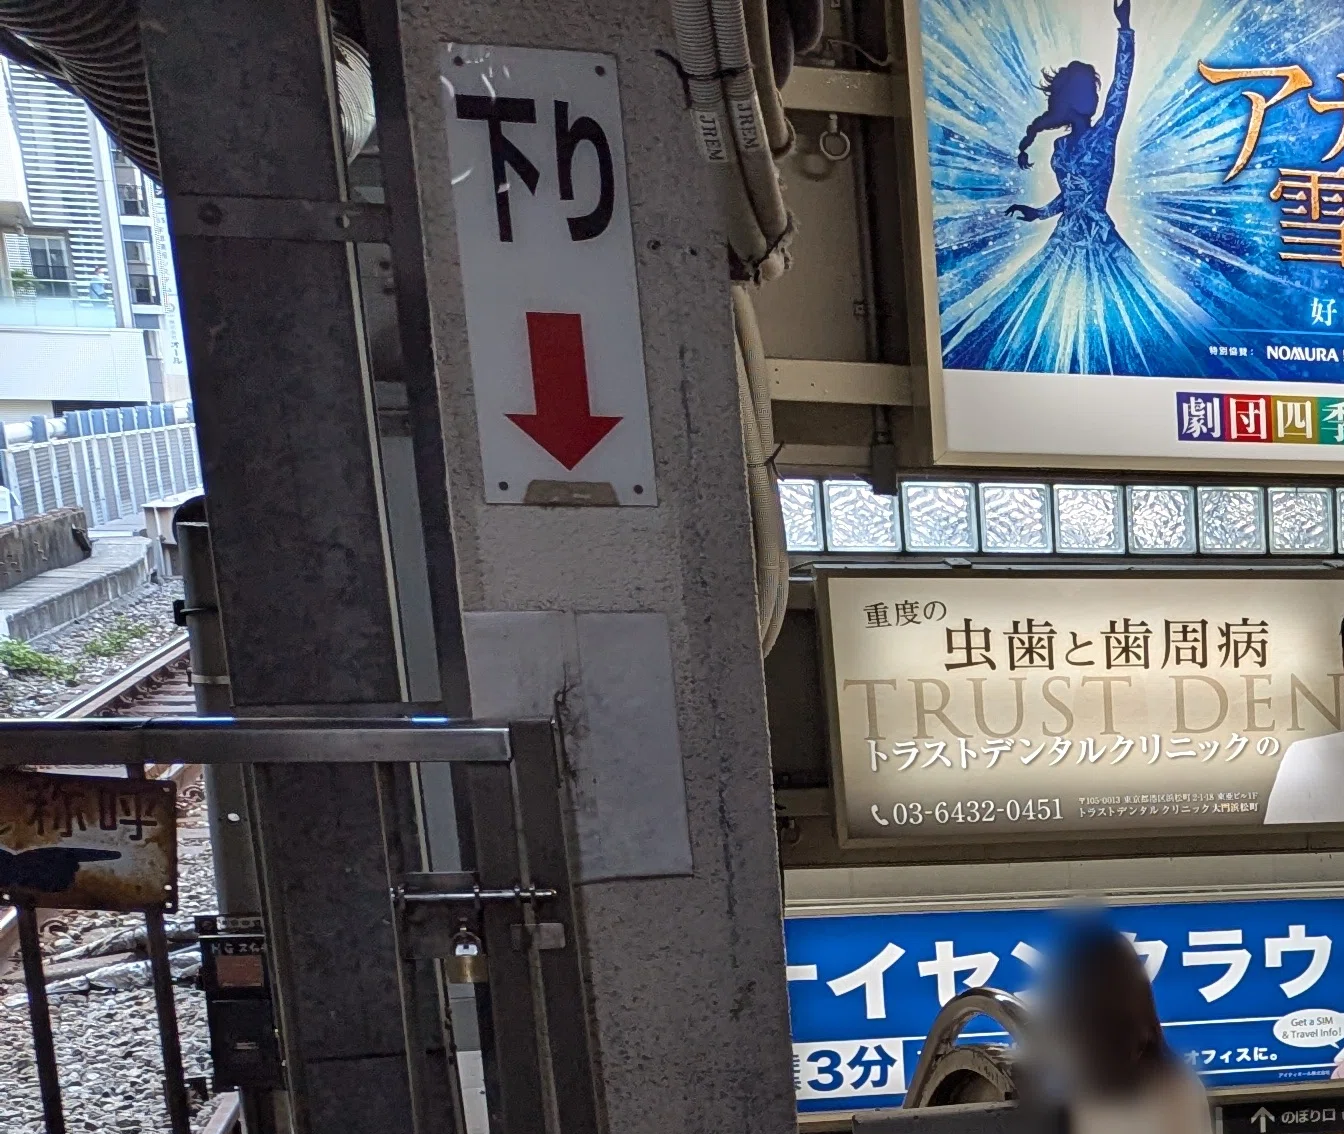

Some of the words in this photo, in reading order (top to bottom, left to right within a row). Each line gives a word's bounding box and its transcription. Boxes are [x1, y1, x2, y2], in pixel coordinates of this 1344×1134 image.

[700, 115, 724, 160] JREM
[737, 103, 759, 149] JREM
[455, 94, 614, 242] 下り
[1266, 345, 1339, 363] NOMURA
[863, 600, 947, 629] 重度の
[944, 617, 1270, 672] 虫歯と歯周病
[843, 675, 1132, 741] TRUST
[867, 732, 1280, 772] トラストデンタルクリニックの
[893, 798, 1064, 826] 03-6432-0451
[1291, 1018, 1307, 1027] Get
[1317, 1016, 1333, 1025] SIM
[1291, 1029, 1318, 1038] Travel
[1321, 1027, 1342, 1037] Info!
[1281, 1108, 1336, 1124] のぼり口
